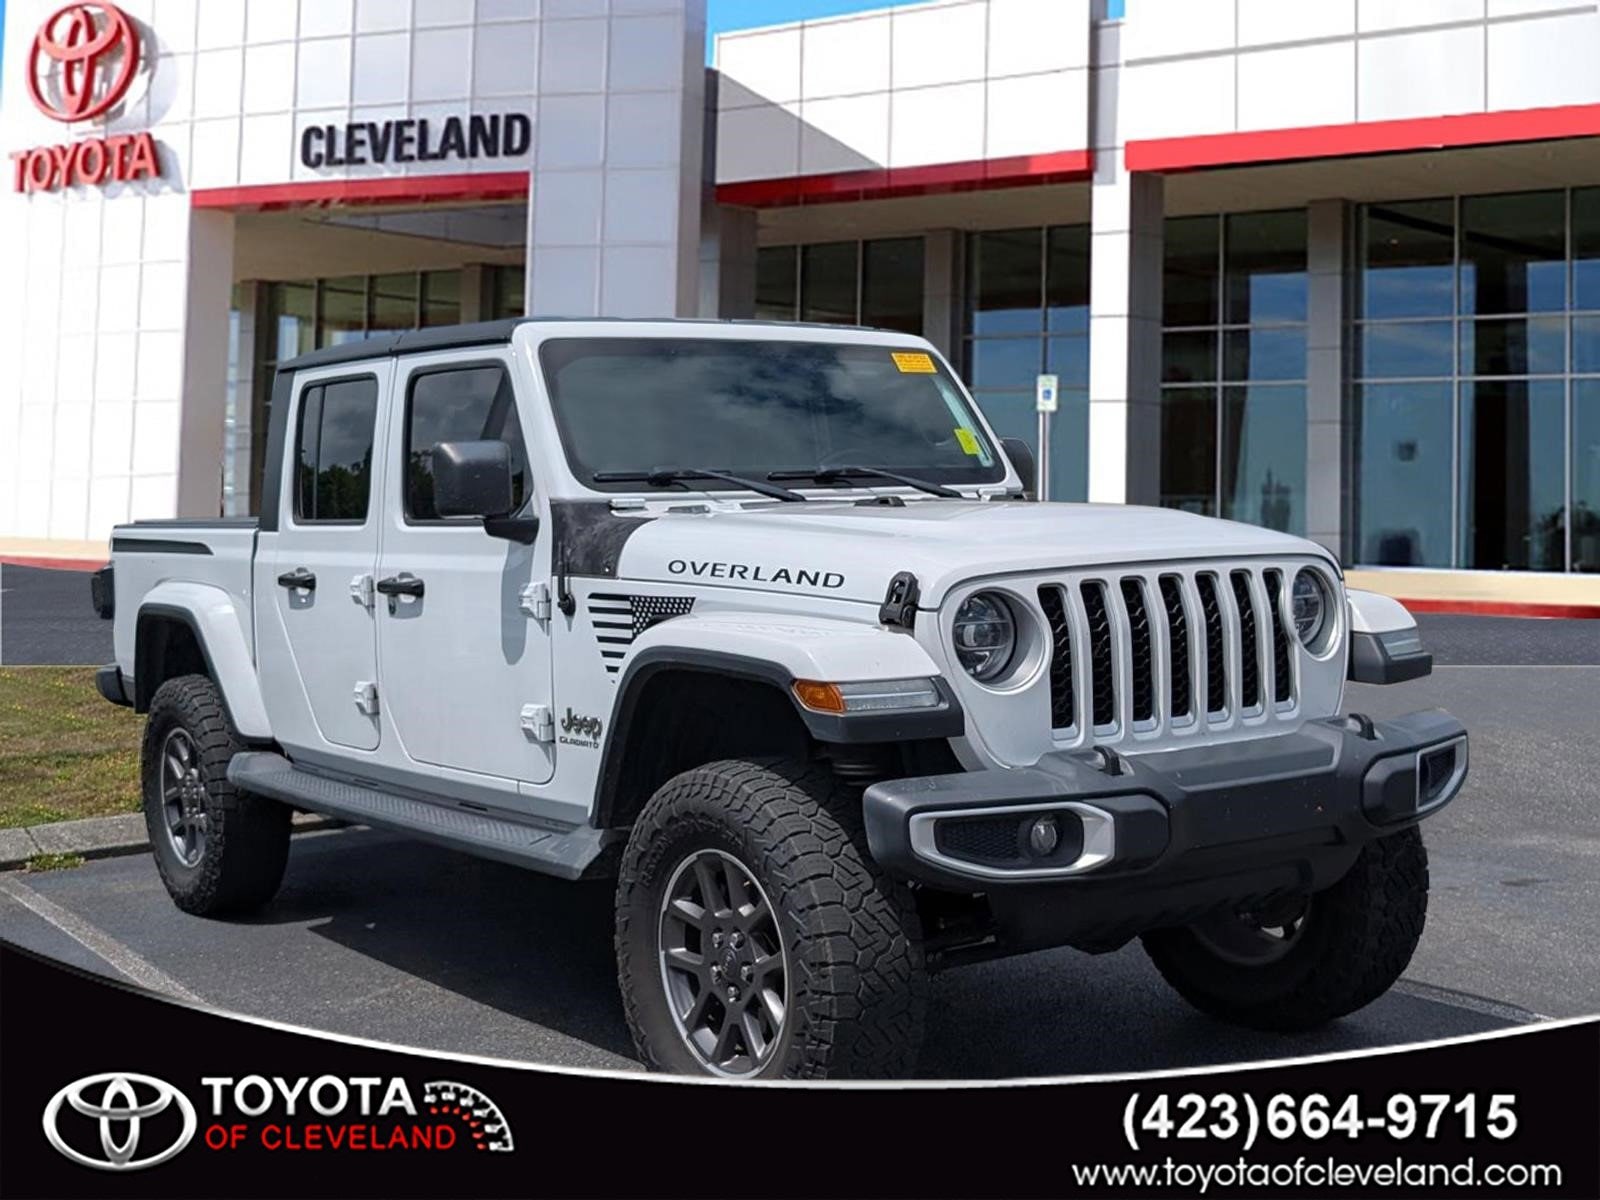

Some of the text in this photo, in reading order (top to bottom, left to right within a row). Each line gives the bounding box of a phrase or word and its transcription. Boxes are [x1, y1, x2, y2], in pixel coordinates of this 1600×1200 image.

[9, 132, 160, 192] TOYOTA
[301, 113, 531, 169] CLEVELAND
[667, 559, 845, 588] OVERLAND
[560, 707, 603, 741] Jeep
